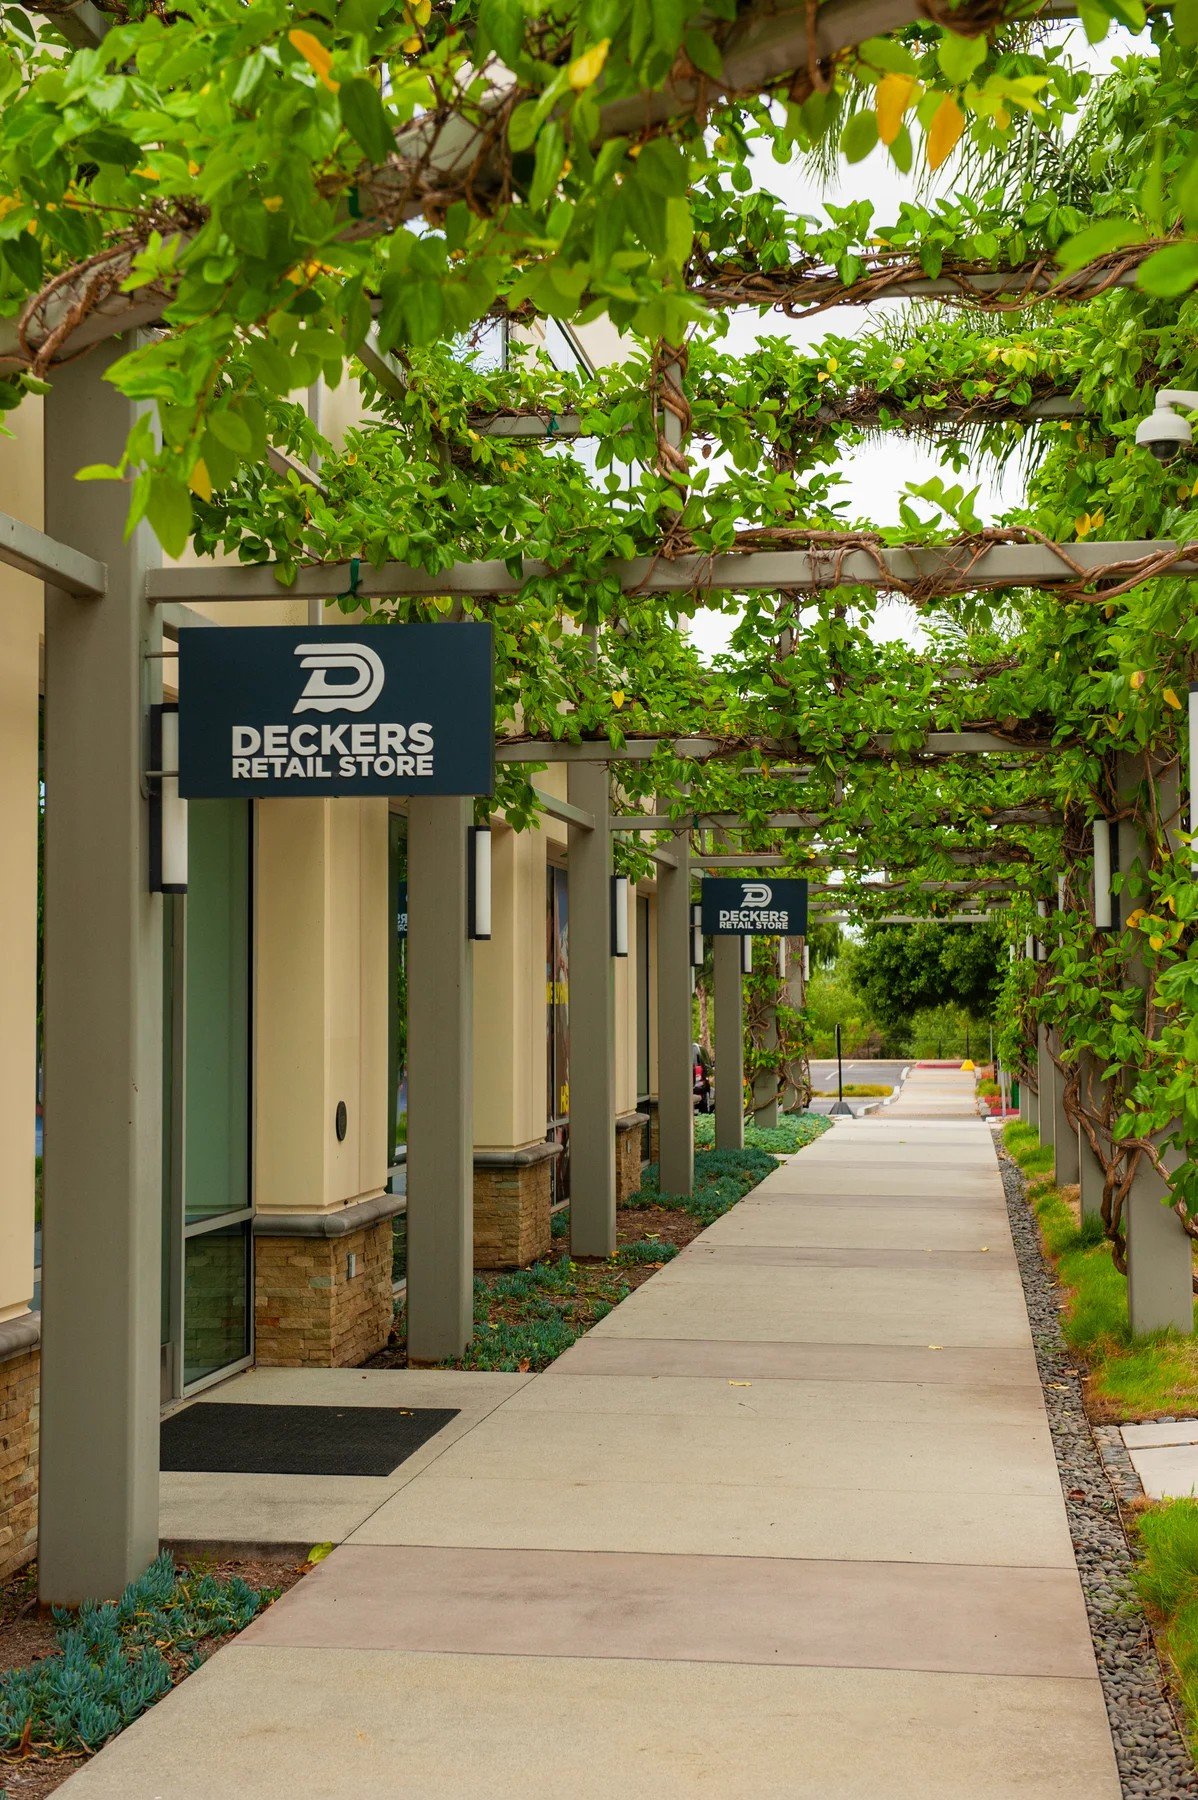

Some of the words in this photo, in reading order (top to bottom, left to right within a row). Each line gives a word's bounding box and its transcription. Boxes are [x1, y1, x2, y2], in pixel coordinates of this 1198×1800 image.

[232, 722, 434, 757] DECKERS
[232, 756, 332, 779] RETAIL
[338, 755, 434, 777] STORE
[719, 910, 789, 922] DECKERS
[719, 921, 754, 930] RETAIL
[755, 921, 789, 930] STORE
